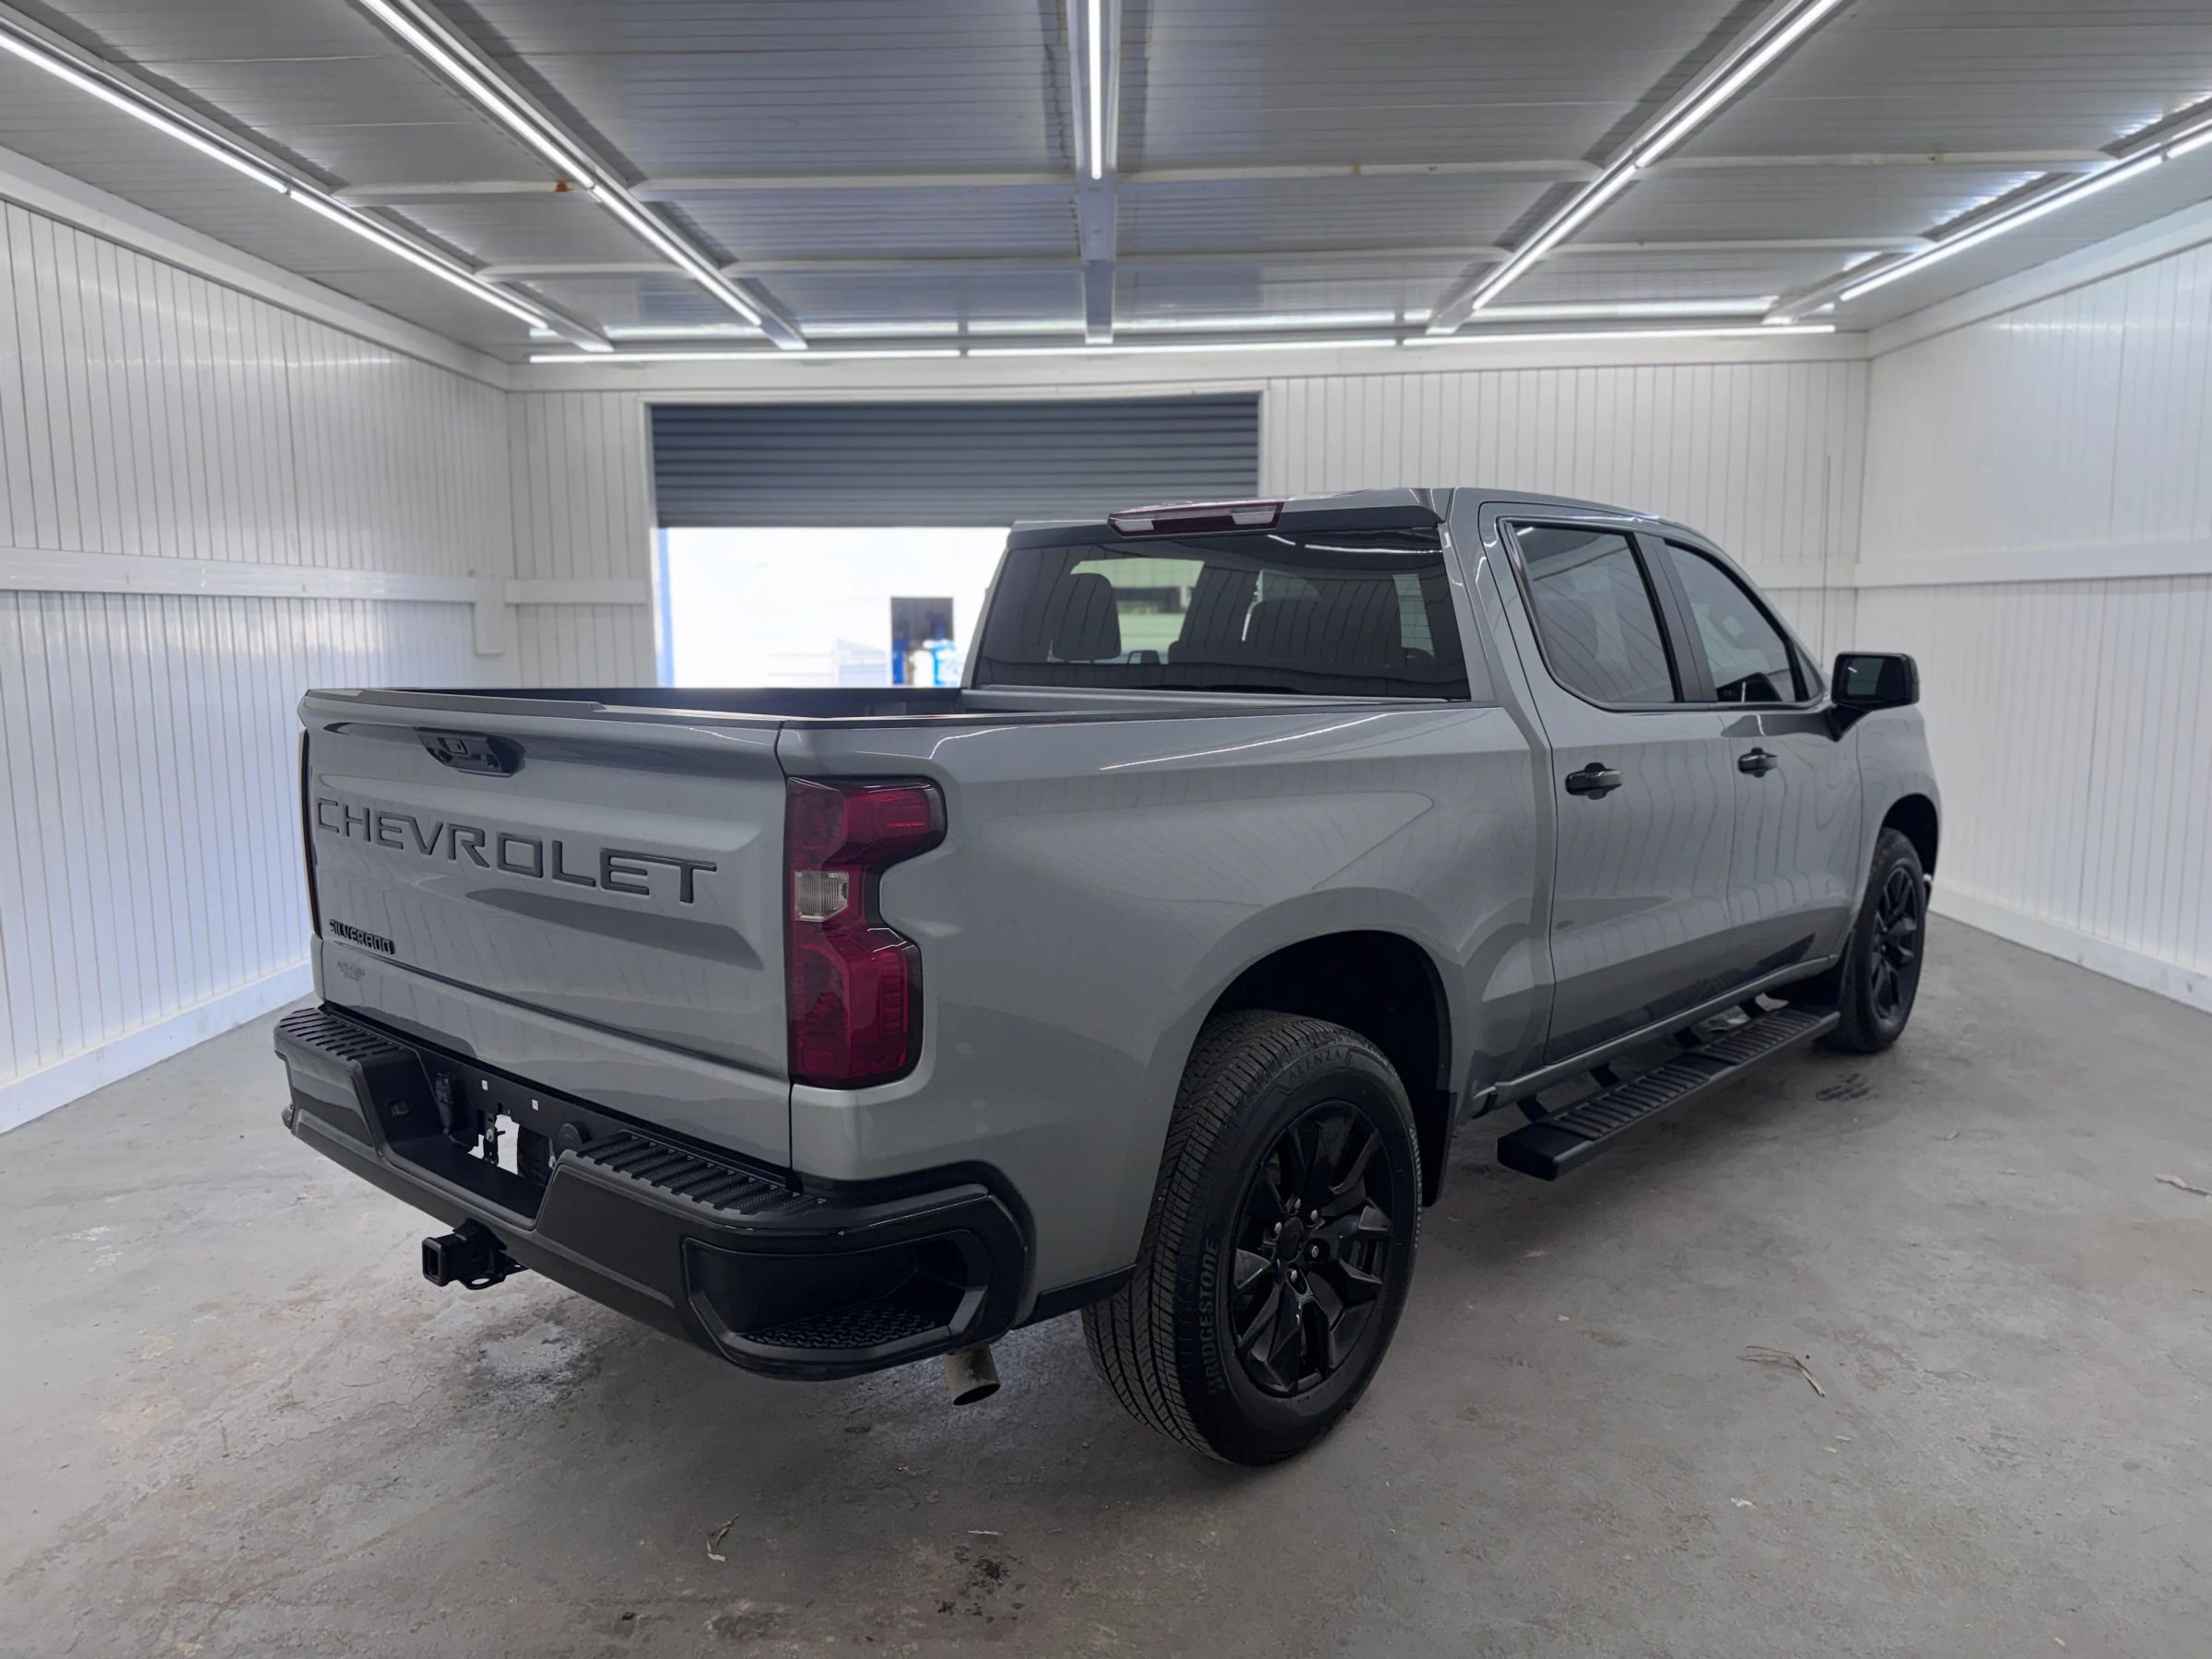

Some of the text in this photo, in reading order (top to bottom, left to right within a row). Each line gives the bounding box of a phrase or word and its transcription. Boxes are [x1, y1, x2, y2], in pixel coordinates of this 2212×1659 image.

[316, 797, 718, 904] CHEVROLET
[329, 918, 395, 955] SILVERADO
[1289, 1049, 1342, 1083] ALENZA
[1198, 1238, 1227, 1394] BRIDGESTONE
